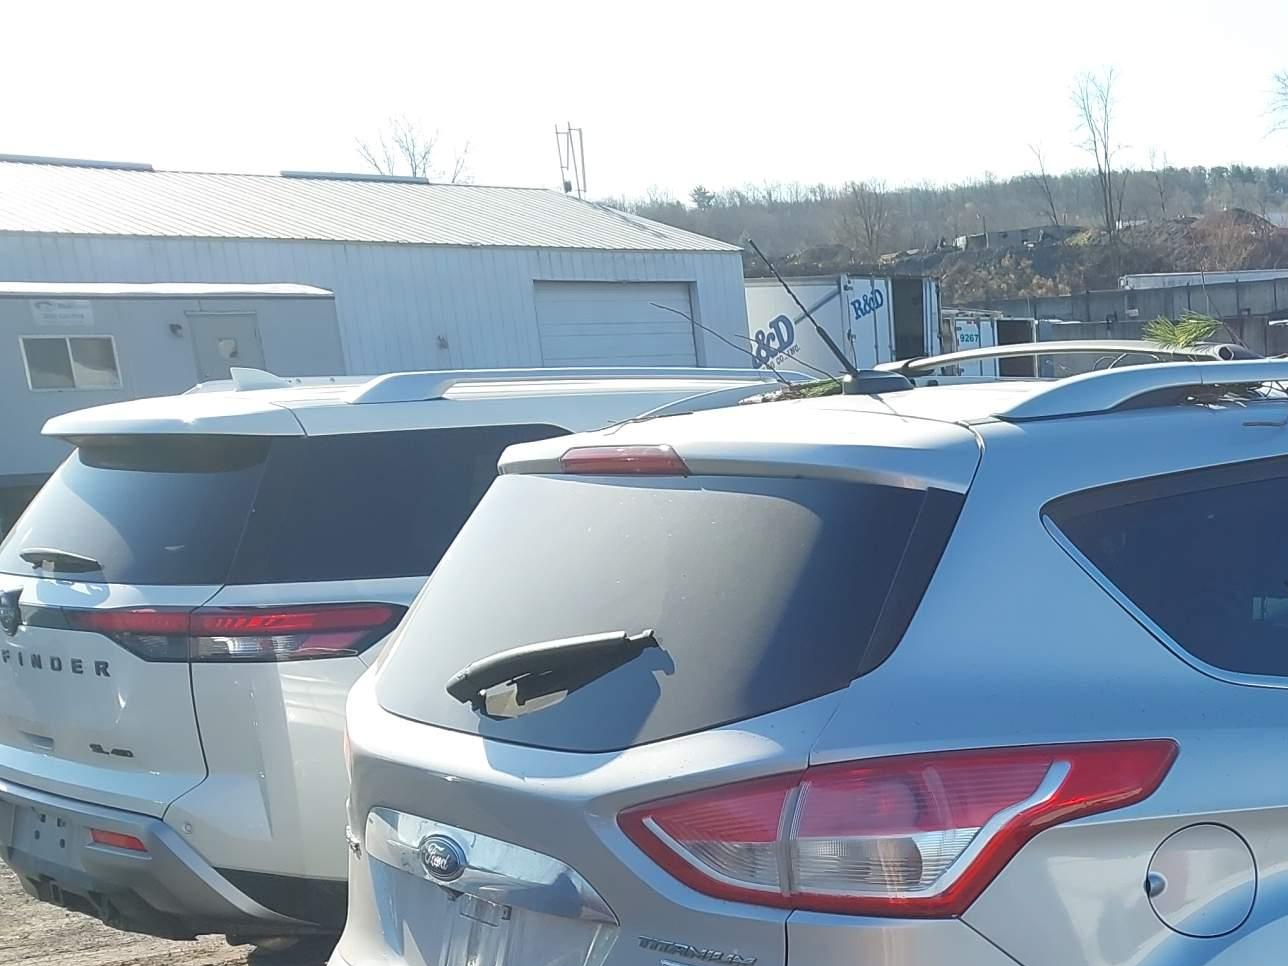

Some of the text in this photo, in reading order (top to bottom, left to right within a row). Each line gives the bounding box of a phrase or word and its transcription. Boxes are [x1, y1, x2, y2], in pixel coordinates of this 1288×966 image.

[851, 289, 883, 320] R&D
[960, 334, 979, 342] 9267
[2, 649, 111, 677] FINDER
[425, 842, 450, 870] Ford
